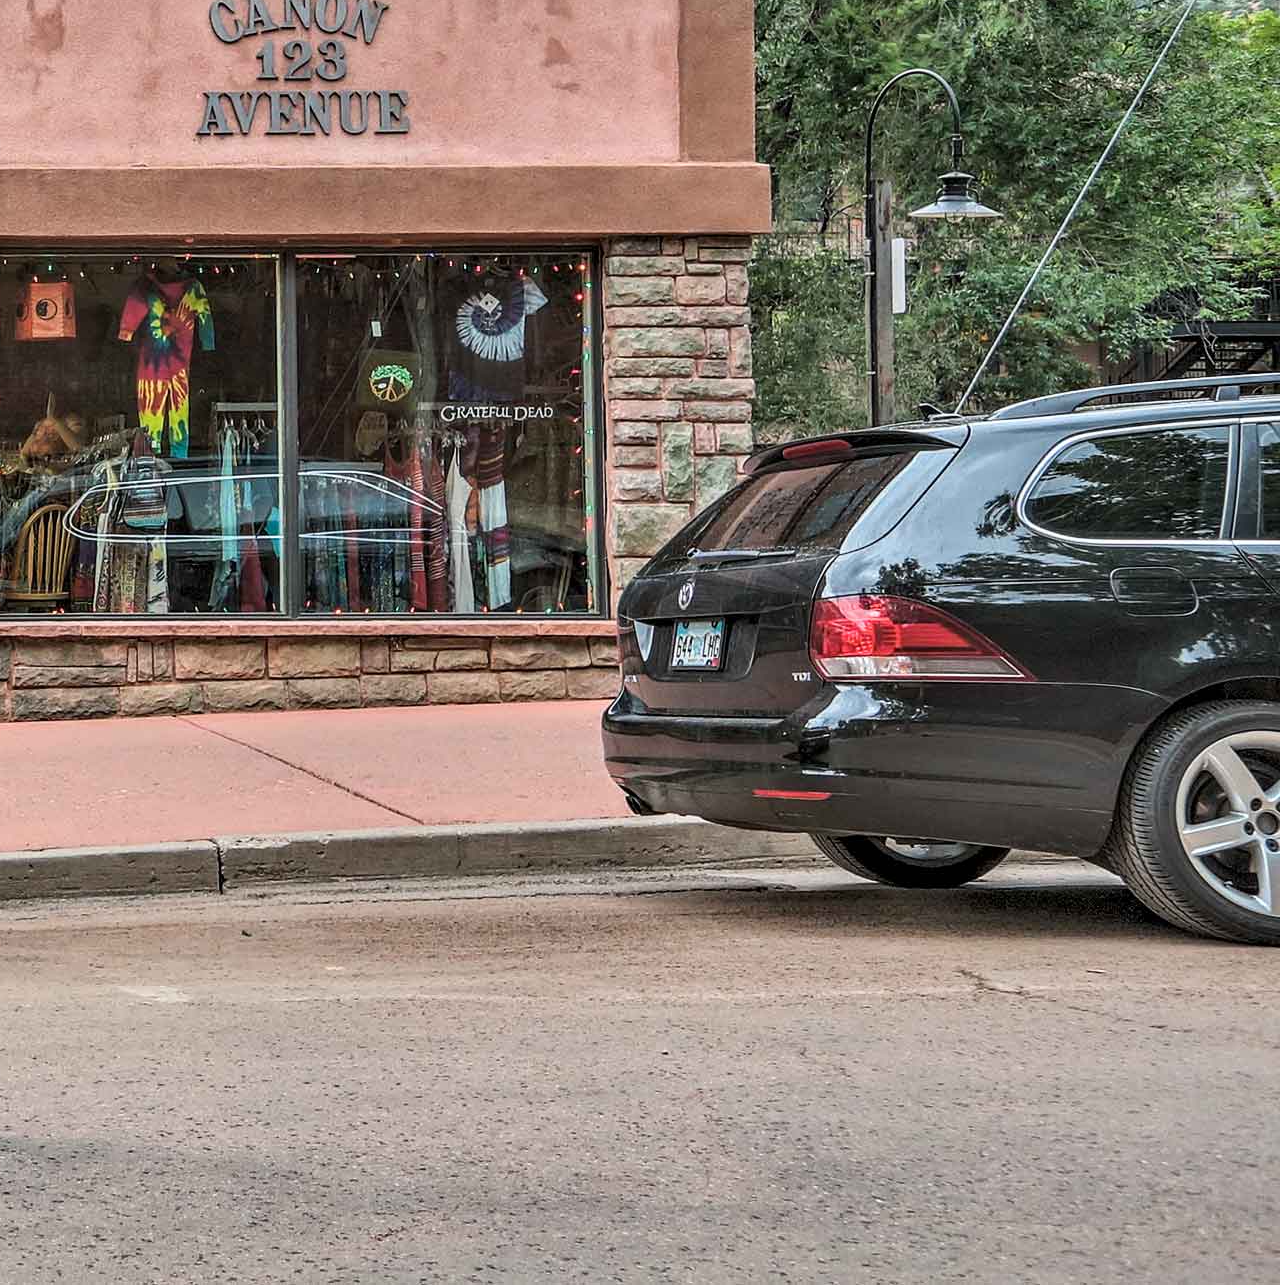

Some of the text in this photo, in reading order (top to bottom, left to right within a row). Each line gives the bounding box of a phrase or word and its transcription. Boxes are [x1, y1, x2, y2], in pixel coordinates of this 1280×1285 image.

[256, 39, 348, 82] 123
[196, 90, 411, 136] AVENUE
[440, 405, 554, 422] GRATEFUL DEAD
[791, 671, 811, 682] TDI
